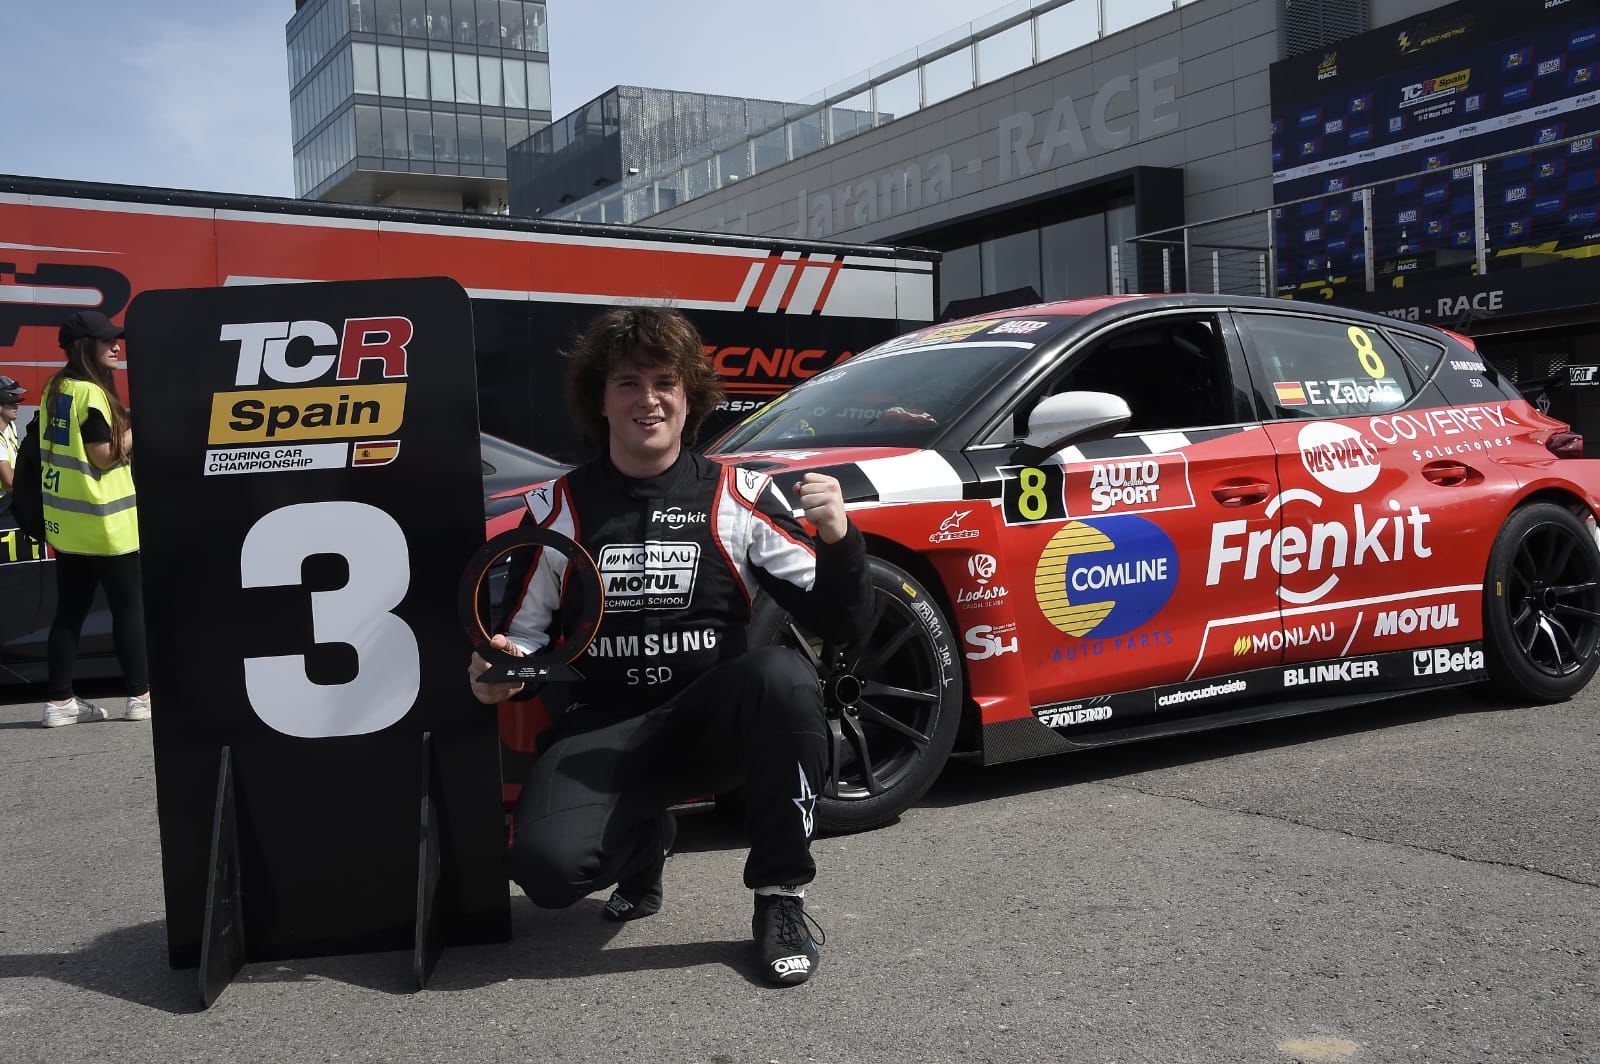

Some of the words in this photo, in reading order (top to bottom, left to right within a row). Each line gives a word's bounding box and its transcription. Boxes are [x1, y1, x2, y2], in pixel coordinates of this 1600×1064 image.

[1439, 74, 1466, 87] Spain
[791, 148, 953, 238] Jarama
[1000, 57, 1181, 182] RACE
[1437, 290, 1503, 317] RACE
[1001, 320, 1049, 329] AUTO
[219, 316, 413, 386] TCR
[1347, 326, 1385, 379] 8
[1450, 360, 1487, 372] SAMSUNG
[1469, 379, 1483, 388] SSD
[229, 394, 380, 437] Spain
[1369, 405, 1519, 445] COVERFIX
[210, 450, 270, 462] TOURING
[275, 449, 302, 459] CAR
[1412, 436, 1512, 460] Soluciones
[208, 458, 313, 472] CHAMPIONSHIP
[1090, 461, 1159, 489] AUTO
[1017, 467, 1048, 520] 8
[1091, 485, 1160, 512] SPORT
[652, 510, 707, 524] Frenkit
[1205, 499, 1433, 587] Frenkit
[623, 550, 691, 566] MONLAU
[608, 574, 680, 592] MOTUL
[1071, 557, 1168, 591] COMLINE
[647, 596, 685, 606] SCHOOL
[240, 501, 420, 739] 3
[1374, 603, 1460, 637] MOTUL
[587, 628, 716, 658] SAMSUNG
[1052, 641, 1105, 663] AUTO
[1114, 629, 1174, 653] PARTS
[1253, 621, 1335, 654] MONLAU
[1284, 661, 1380, 687] BLINKER
[1434, 647, 1484, 674] Beta
[1158, 679, 1247, 707] cuatrocuatrosiete
[774, 958, 811, 973] OMP
